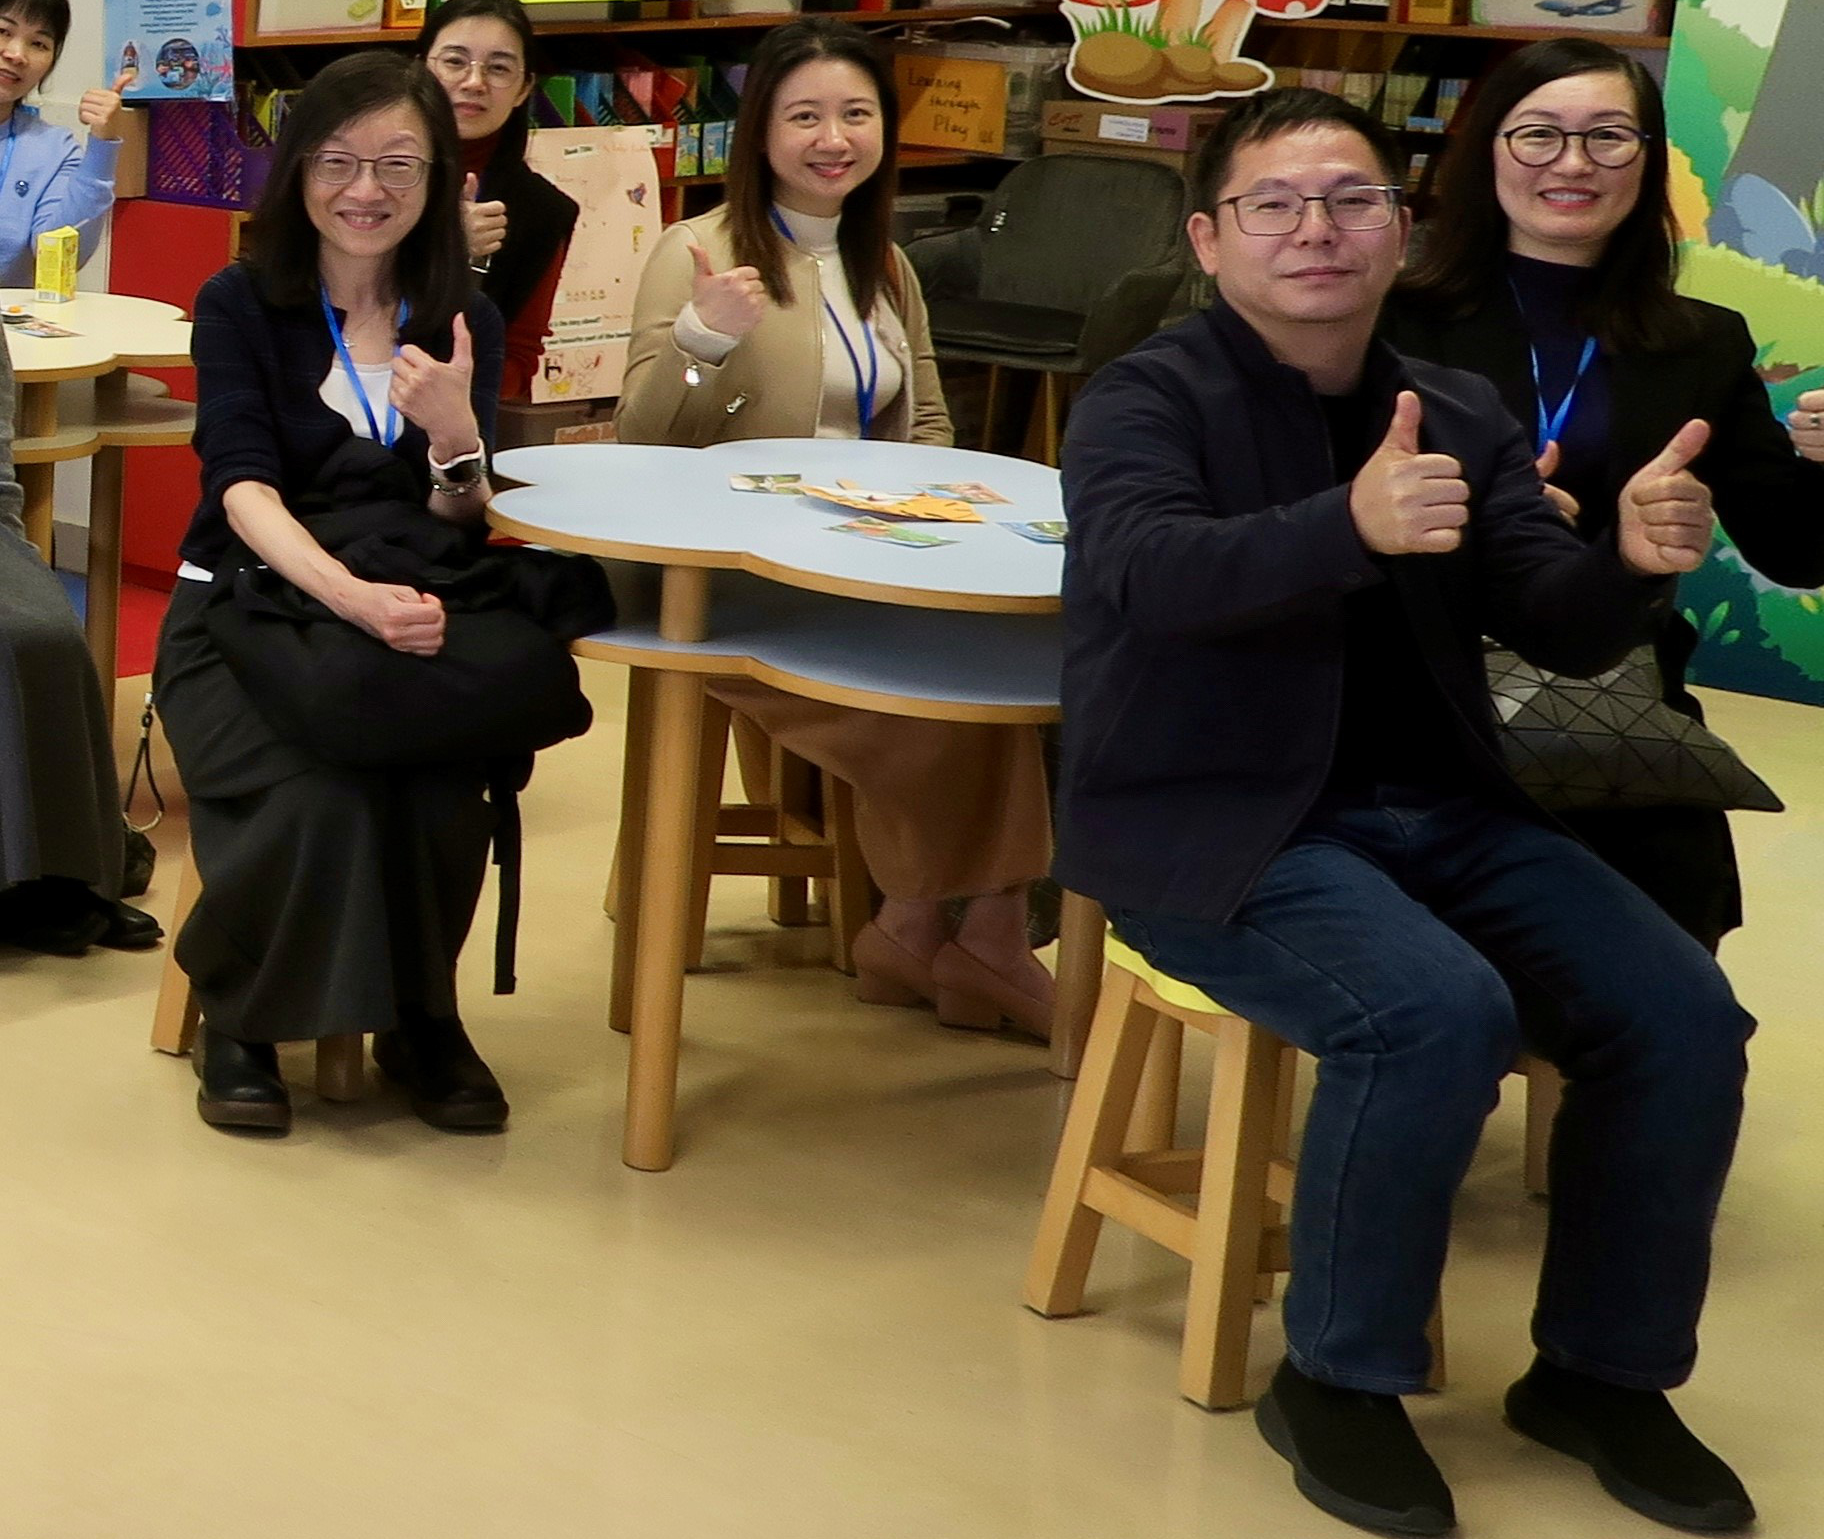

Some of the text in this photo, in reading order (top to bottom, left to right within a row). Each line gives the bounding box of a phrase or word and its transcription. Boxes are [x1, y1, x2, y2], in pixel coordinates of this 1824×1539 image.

[908, 68, 961, 97] Learning
[929, 95, 981, 115] through
[933, 114, 969, 141] Play
